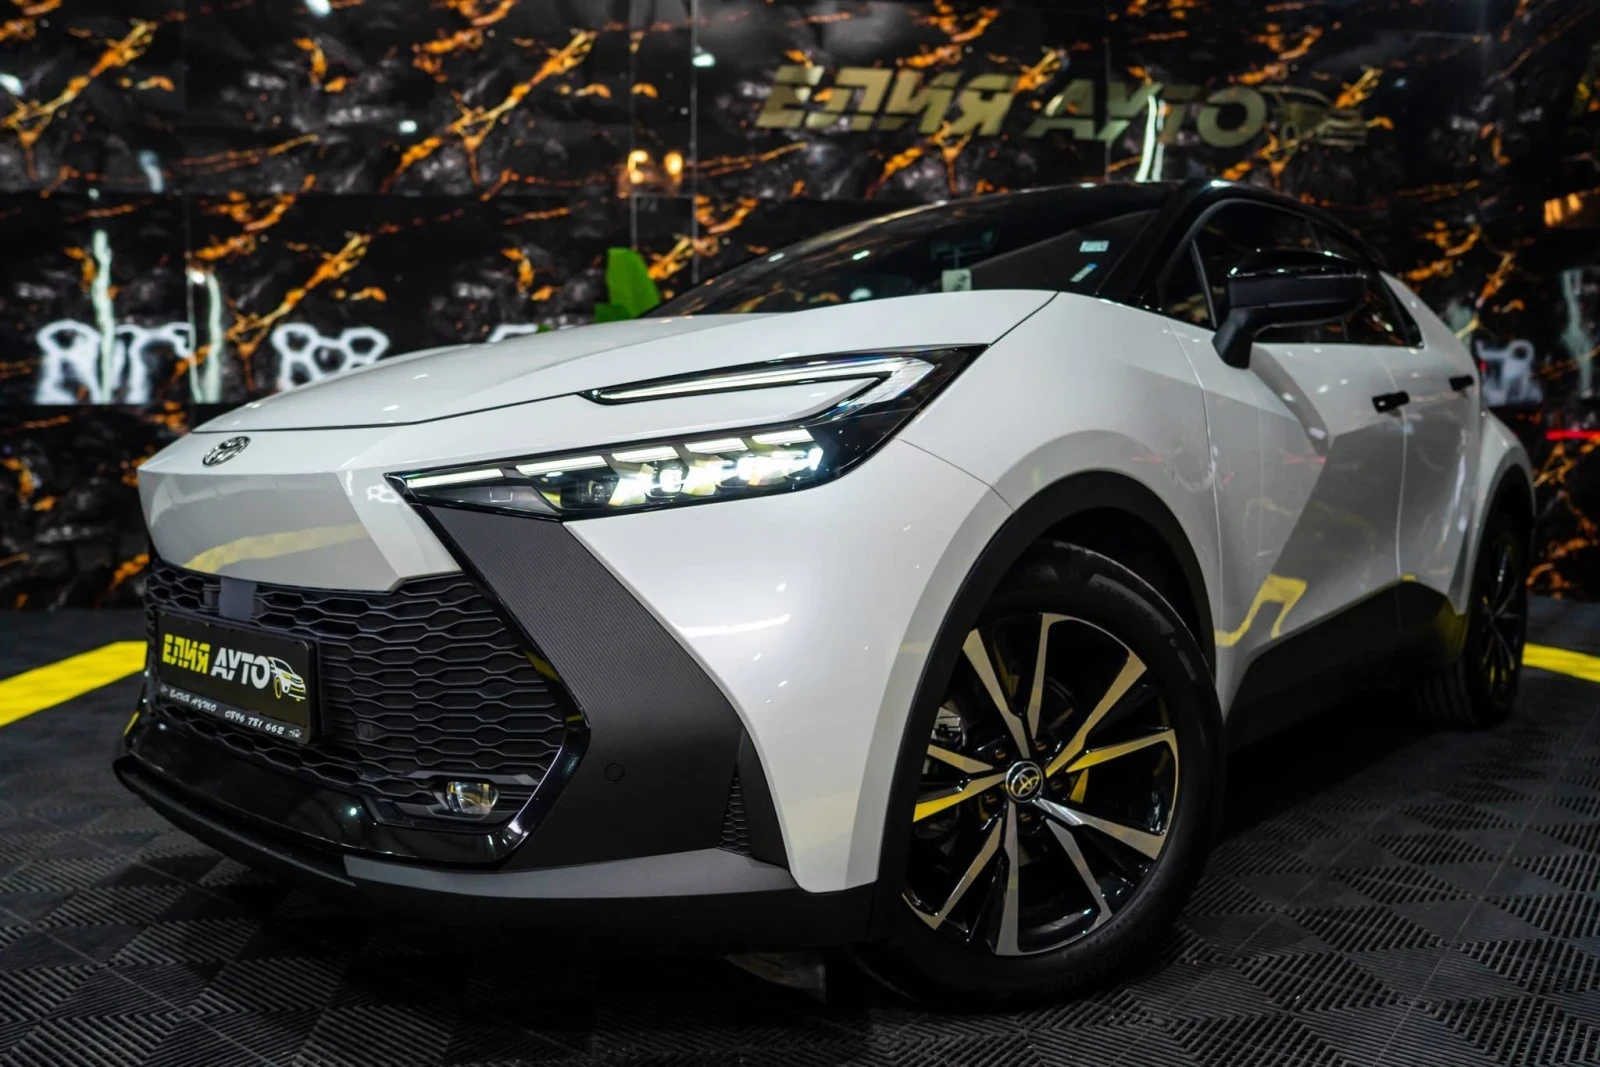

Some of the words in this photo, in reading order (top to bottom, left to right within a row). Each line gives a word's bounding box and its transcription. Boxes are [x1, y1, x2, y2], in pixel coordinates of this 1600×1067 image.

[162, 634, 211, 674] ЕЛИЯ
[224, 710, 245, 723] 0896
[248, 717, 264, 728] 781
[265, 723, 285, 735] 662
